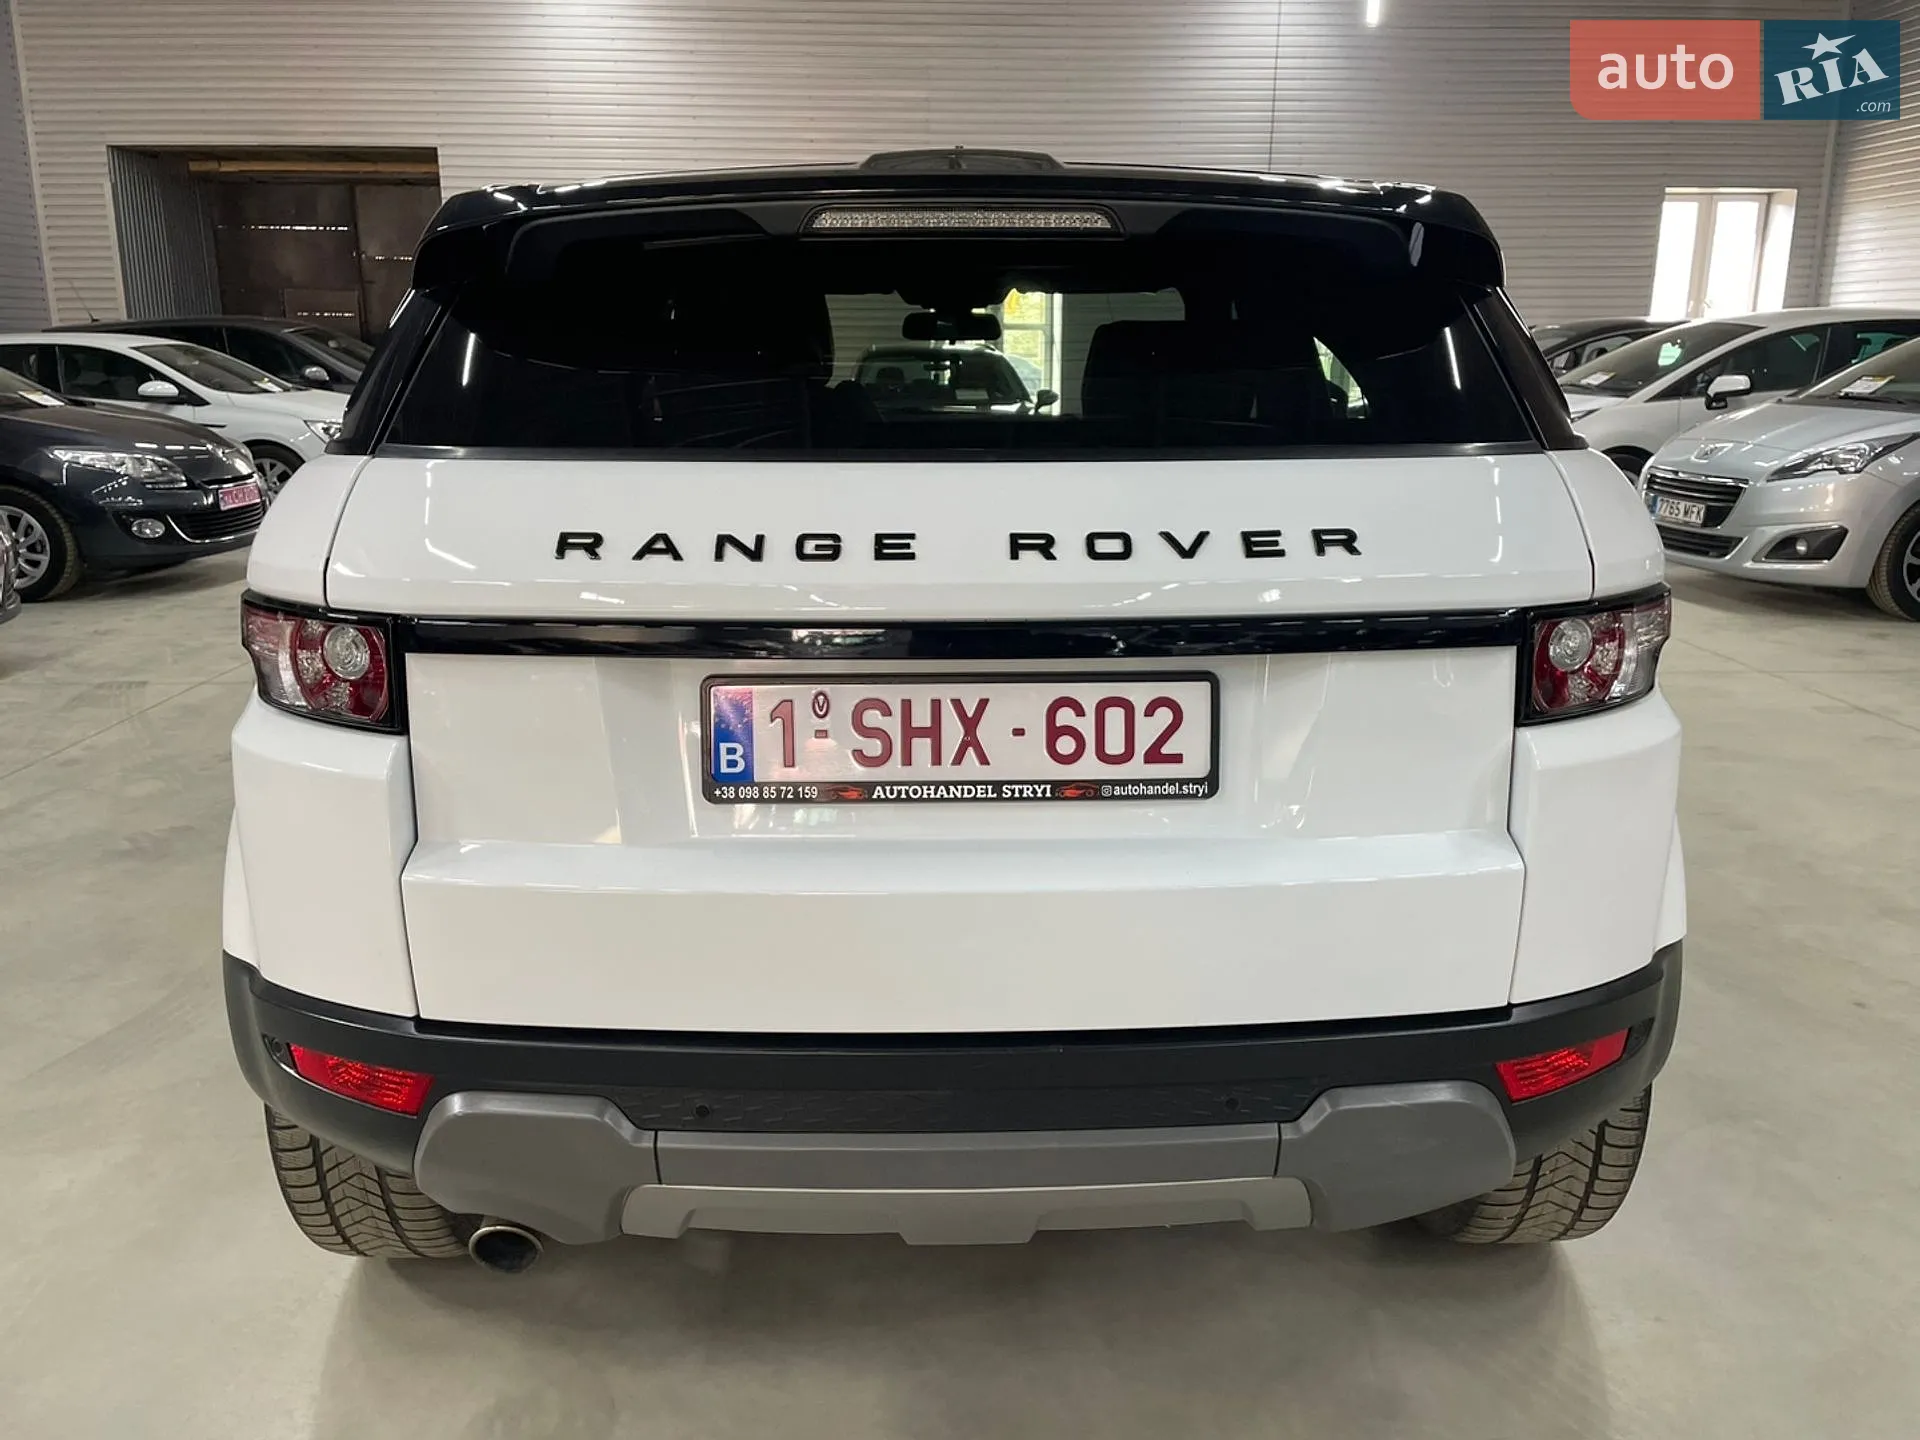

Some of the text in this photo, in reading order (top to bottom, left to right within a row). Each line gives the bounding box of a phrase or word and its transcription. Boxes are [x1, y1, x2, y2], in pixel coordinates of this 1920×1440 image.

[555, 527, 1363, 562] RANGE ROVER
[719, 742, 746, 774] B
[714, 786, 818, 799] +38 098 85 72 159
[872, 784, 1052, 799] AUTOHANDEL STRYI
